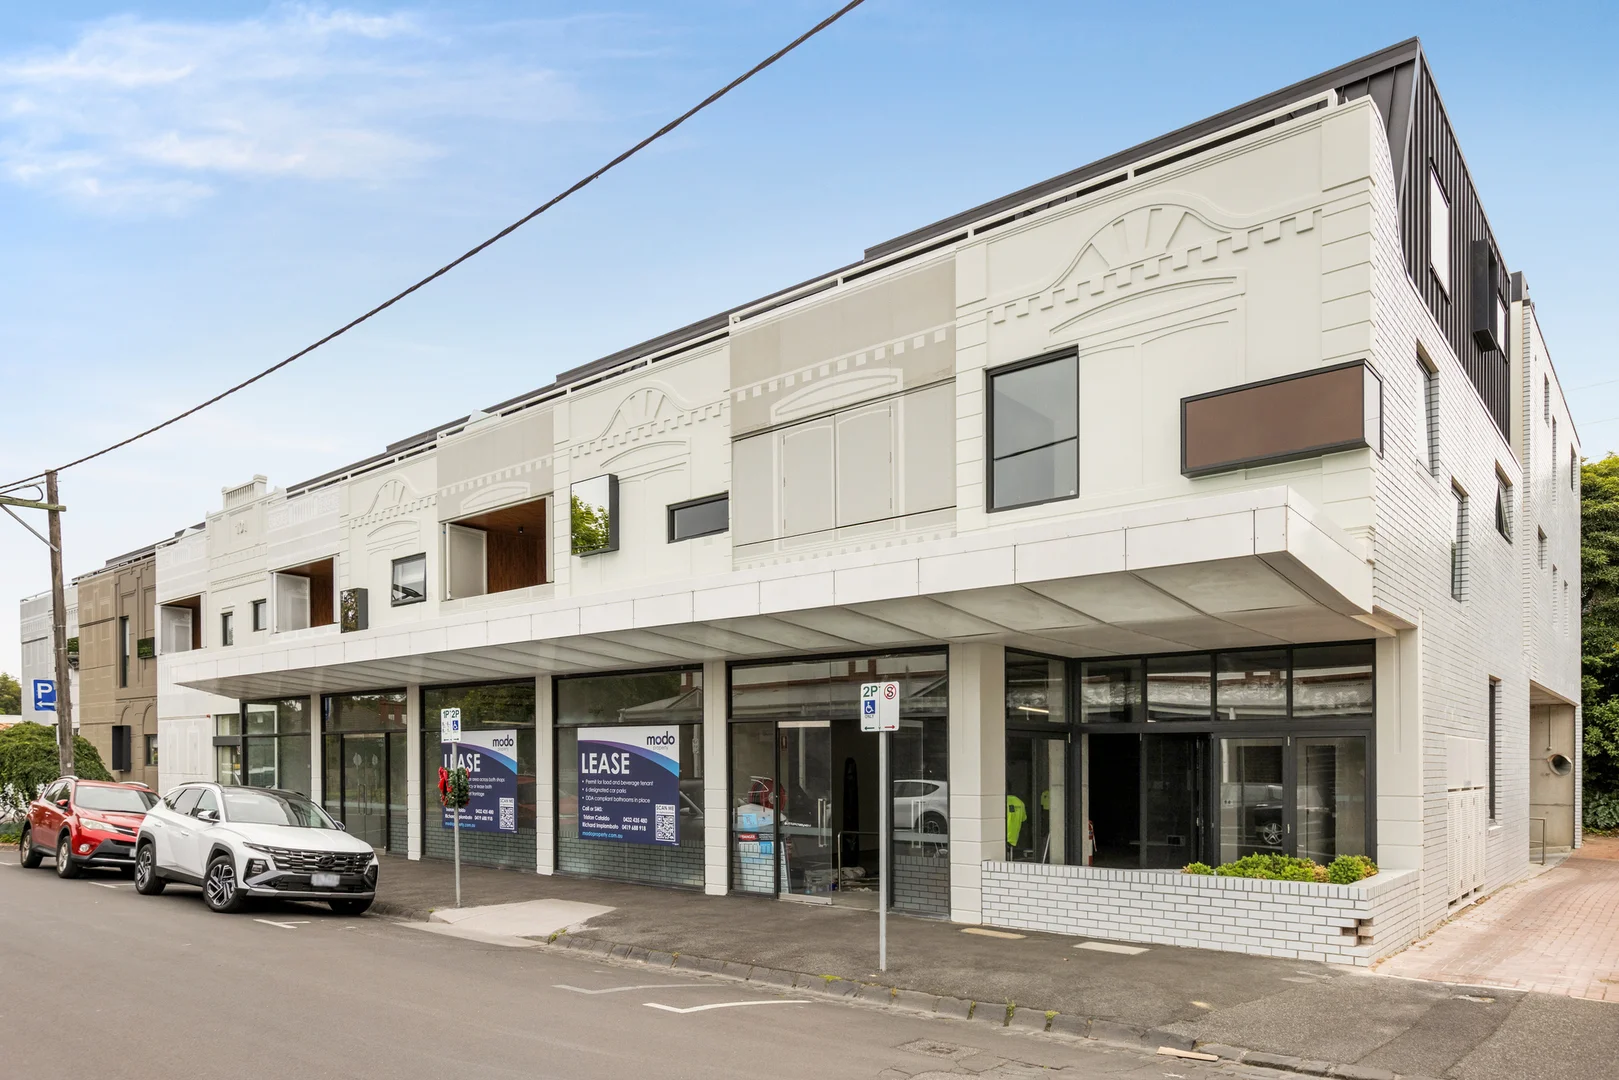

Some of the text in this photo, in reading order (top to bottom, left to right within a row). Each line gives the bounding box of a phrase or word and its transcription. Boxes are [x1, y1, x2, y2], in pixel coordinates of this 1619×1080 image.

[37, 683, 52, 698] P
[863, 686, 878, 697] 2P
[886, 686, 894, 697] S
[452, 710, 459, 718] 2P
[492, 734, 514, 747] modo
[646, 730, 675, 745] modo
[582, 752, 630, 774] LEASE
